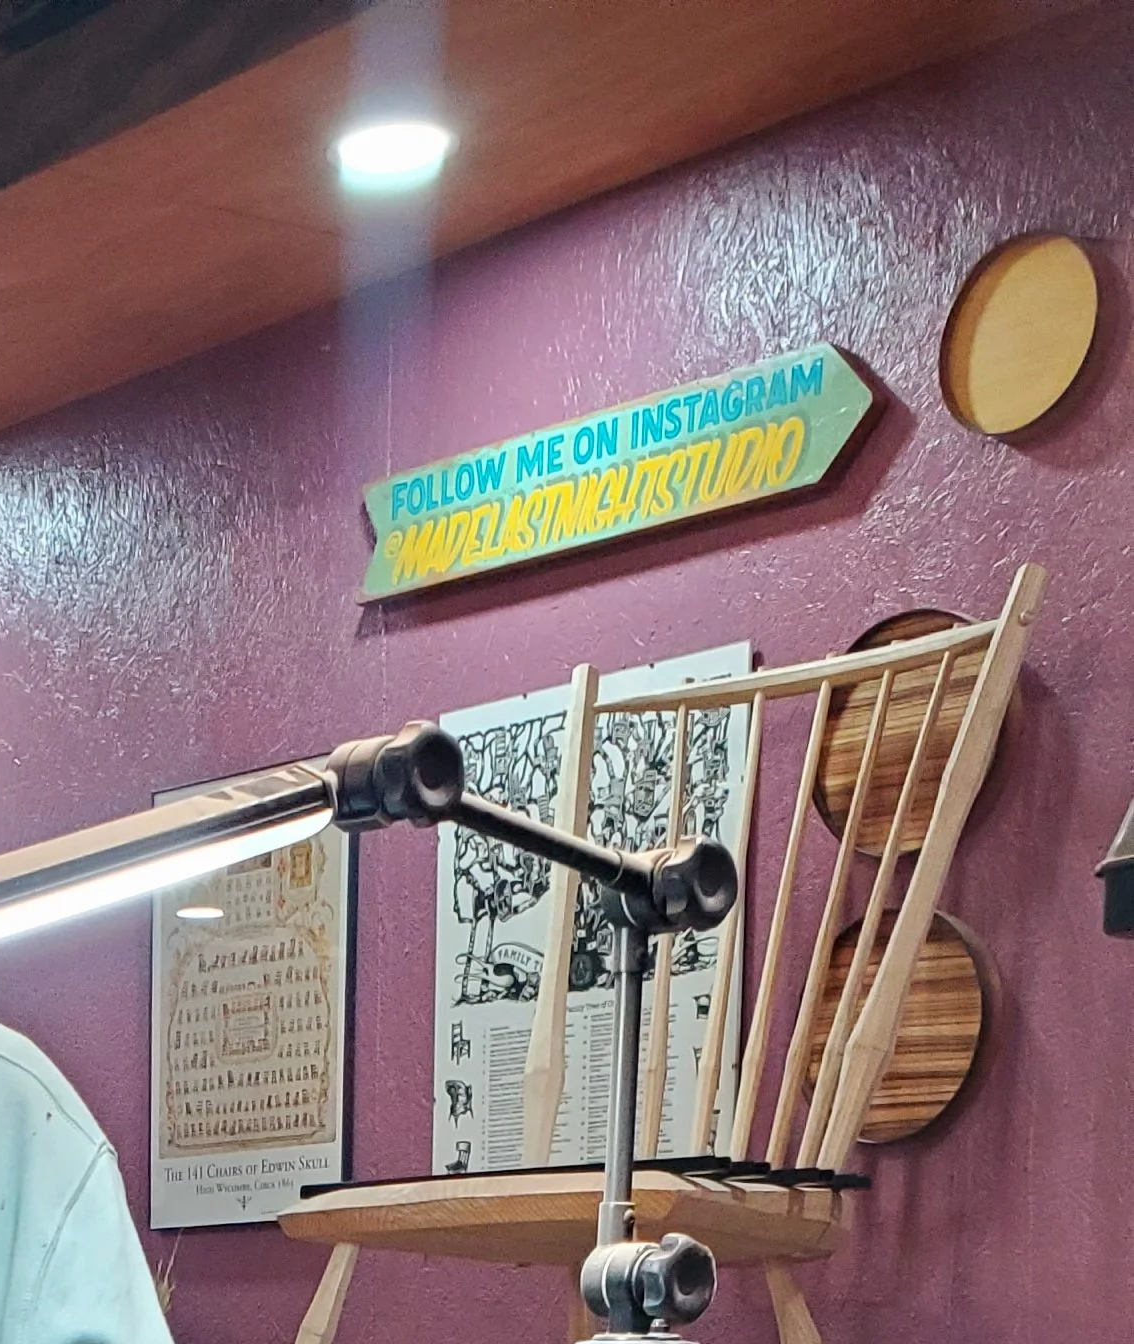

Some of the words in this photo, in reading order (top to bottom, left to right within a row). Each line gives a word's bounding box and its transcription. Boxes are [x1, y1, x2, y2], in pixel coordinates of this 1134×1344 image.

[391, 451, 507, 521] FOLLOW
[516, 434, 565, 484] ME
[572, 416, 619, 465] ON
[630, 356, 825, 450] INSTAGRAM
[497, 948, 532, 967] FAMILY
[164, 1167, 184, 1183] THE
[187, 1165, 203, 1181] 141
[207, 1163, 243, 1179] CHAIRS
[245, 1164, 258, 1176] OF
[261, 1158, 296, 1174] EDWIN
[298, 1155, 330, 1170] SKULL
